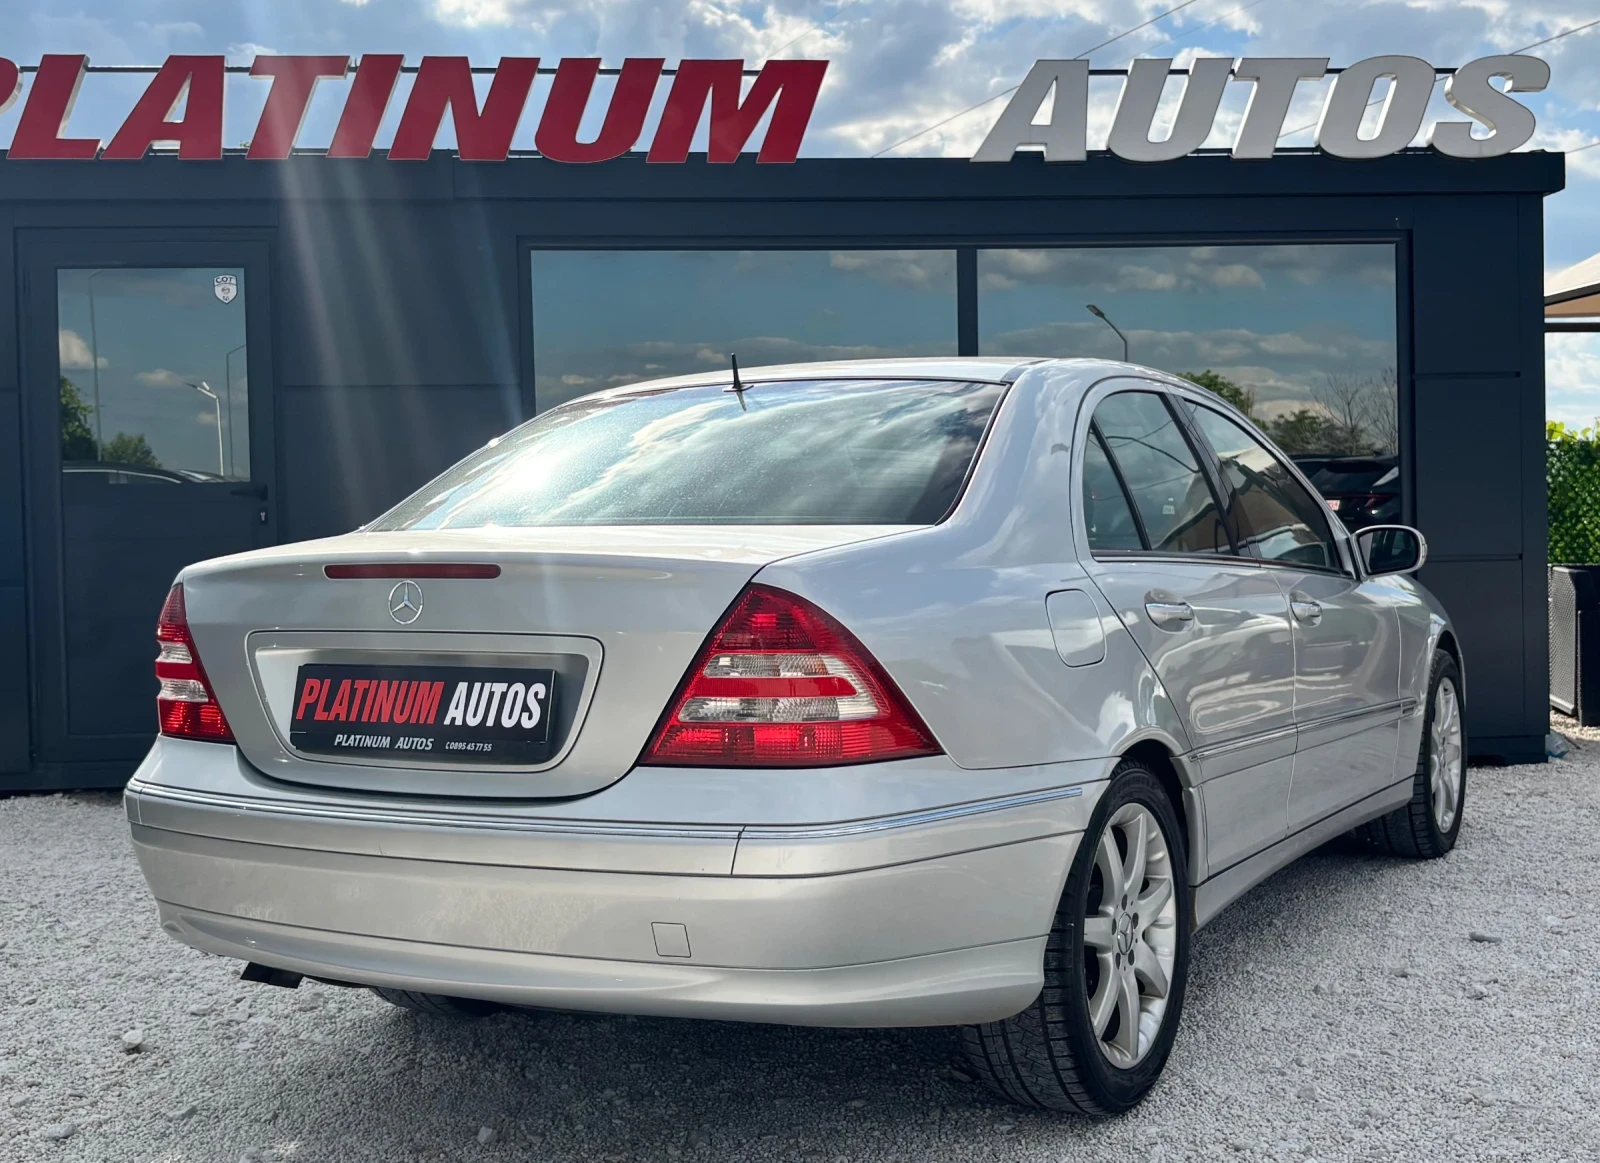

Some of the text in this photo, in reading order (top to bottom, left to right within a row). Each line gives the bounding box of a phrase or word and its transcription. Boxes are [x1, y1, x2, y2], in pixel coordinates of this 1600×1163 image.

[0, 54, 1551, 164] LATINUM AUTOS
[296, 678, 547, 729] PLATINUM AUTOS
[334, 734, 391, 749] PLATINUM
[394, 737, 435, 751] AUTOS
